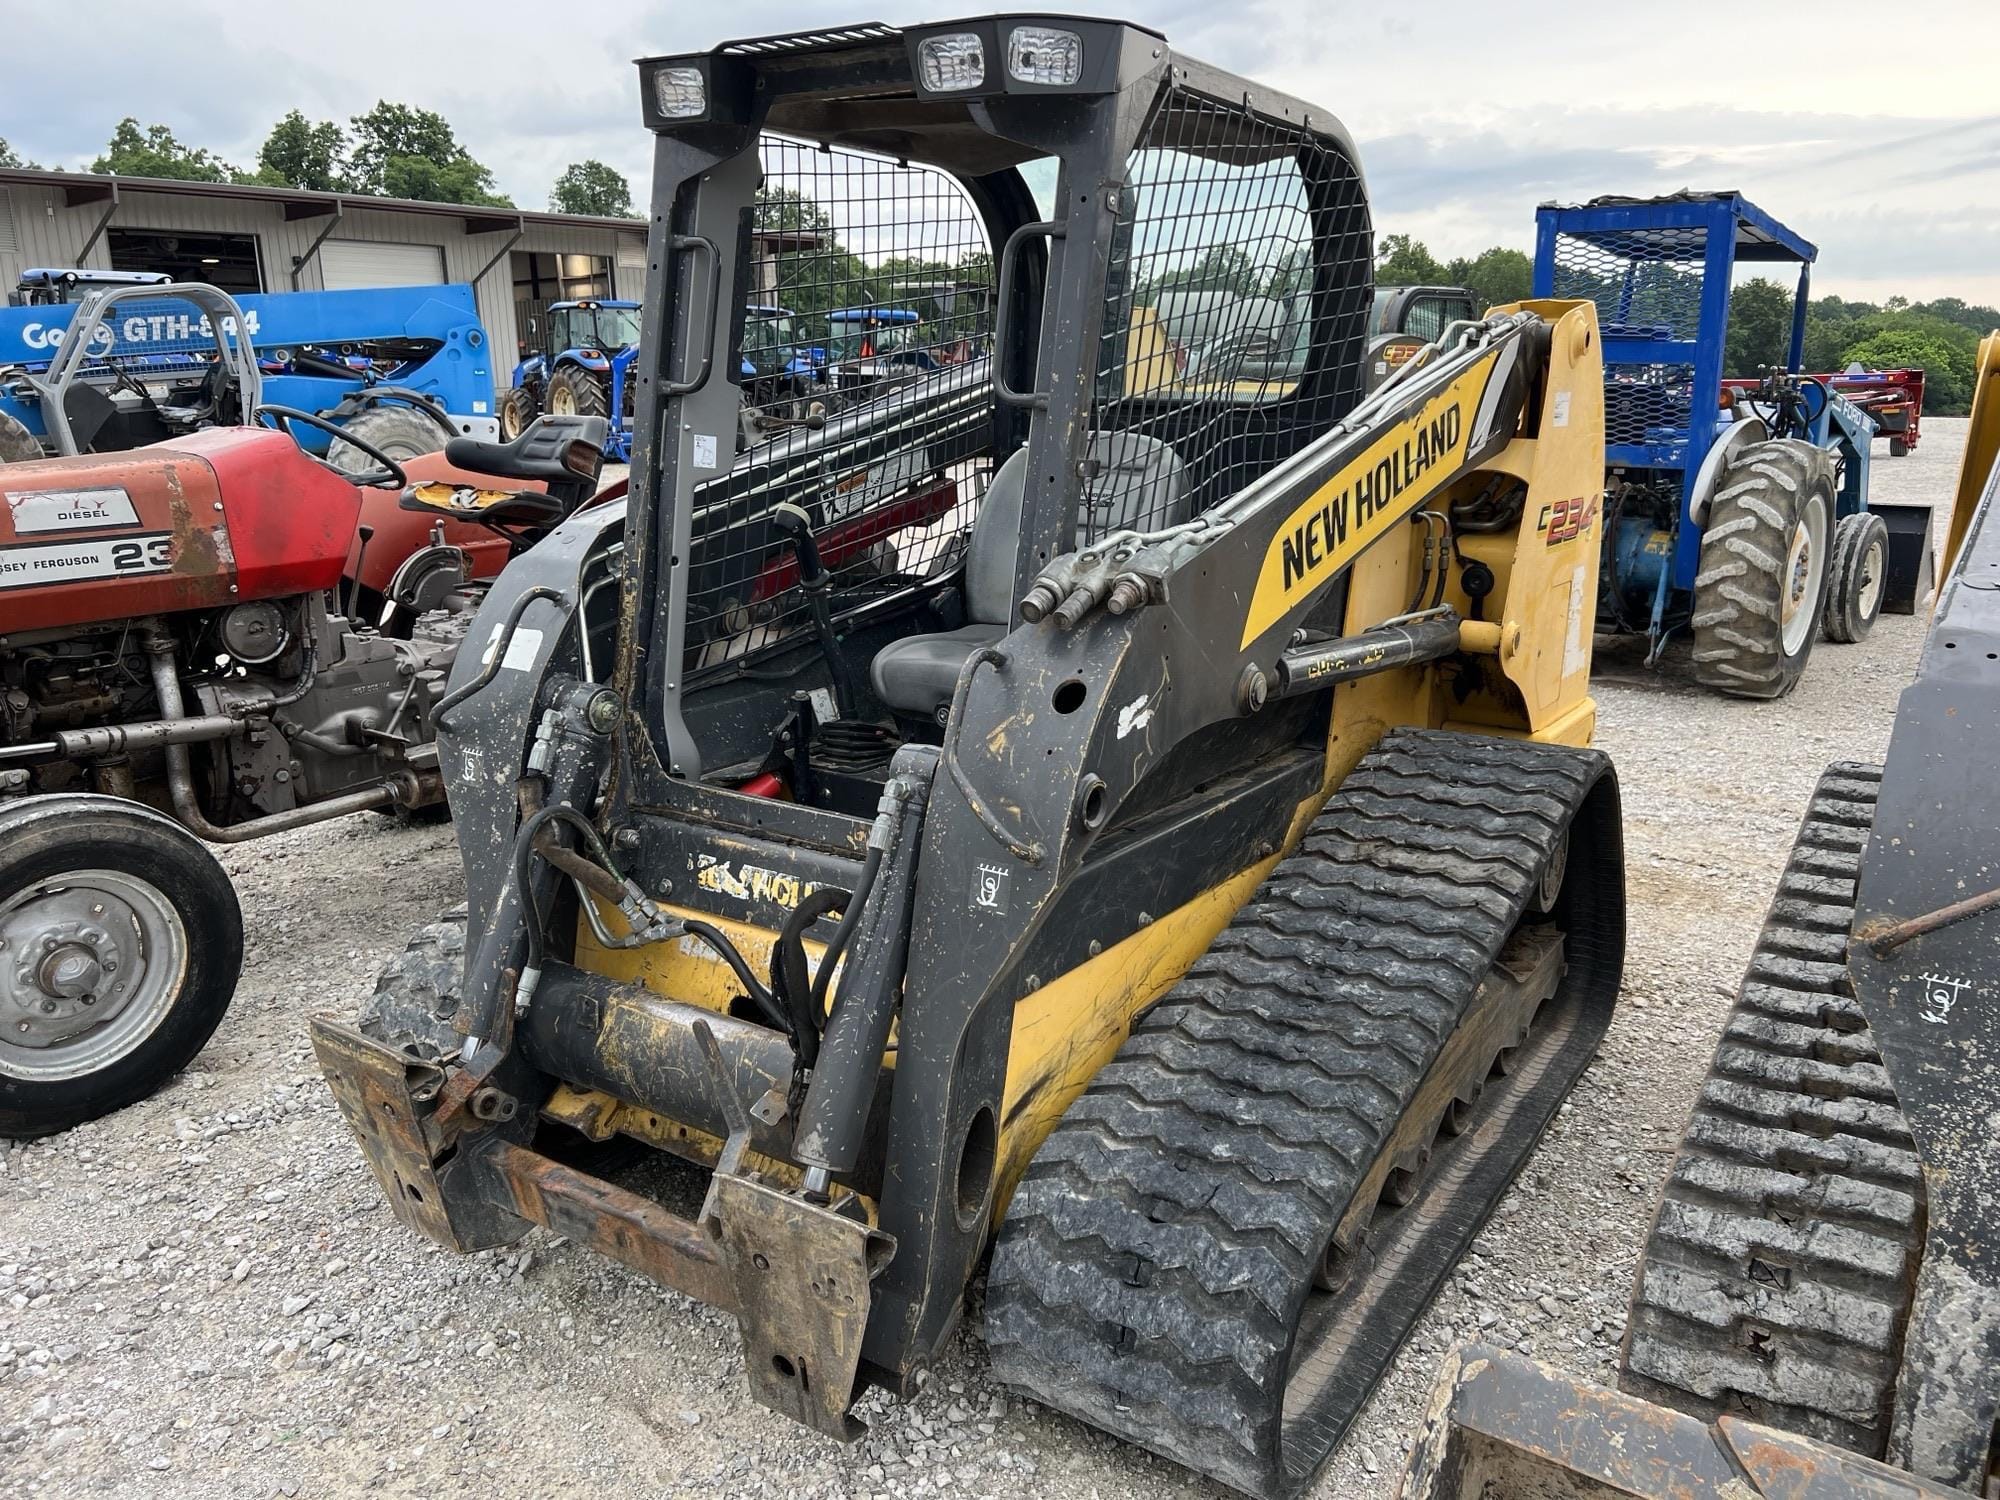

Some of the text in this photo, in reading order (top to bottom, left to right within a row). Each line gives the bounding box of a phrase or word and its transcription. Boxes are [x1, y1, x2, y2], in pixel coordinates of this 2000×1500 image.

[22, 323, 112, 349] Gee
[1842, 401, 1861, 426] FORD
[1282, 402, 1461, 592] NEW HOLLAND
[57, 510, 110, 520] DIESEL
[34, 555, 99, 569] FERGUSON
